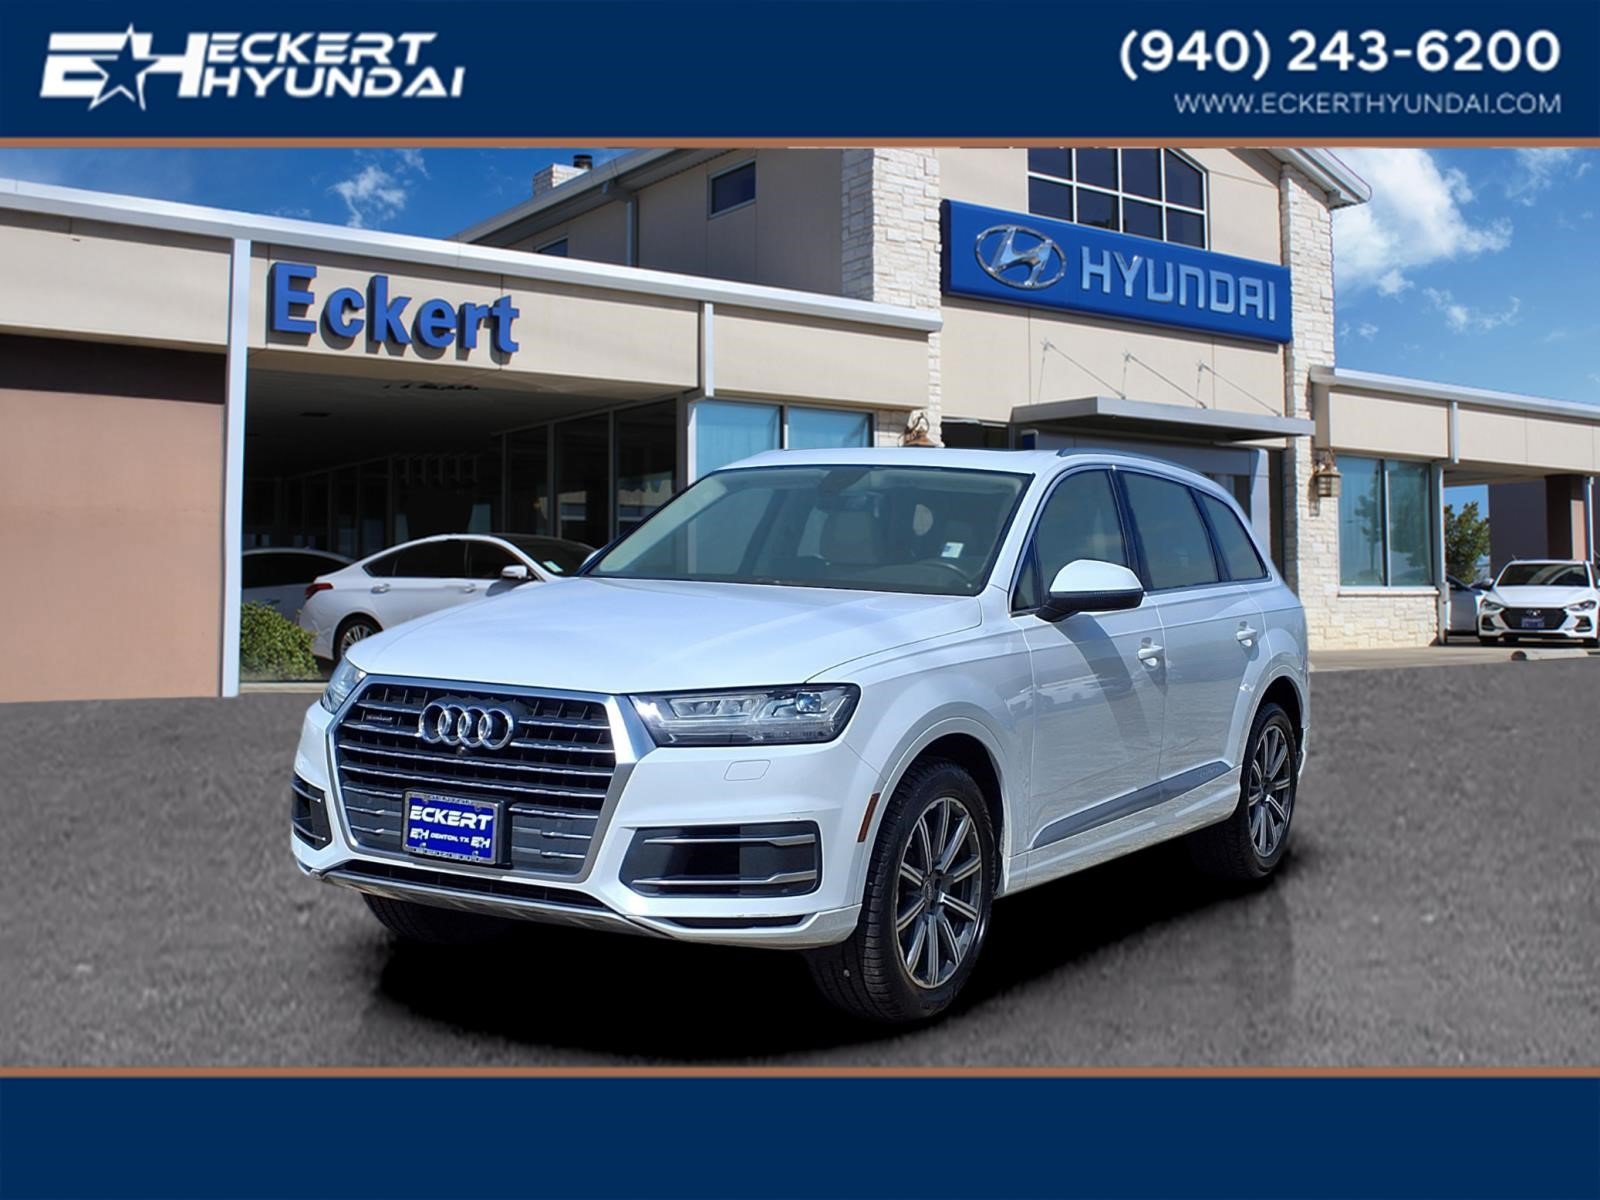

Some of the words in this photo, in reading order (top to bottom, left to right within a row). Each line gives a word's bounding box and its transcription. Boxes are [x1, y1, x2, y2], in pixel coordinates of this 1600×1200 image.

[269, 261, 520, 356] Eckert
[1081, 246, 1277, 322] HYUNDAI
[409, 804, 494, 831] ECKERT
